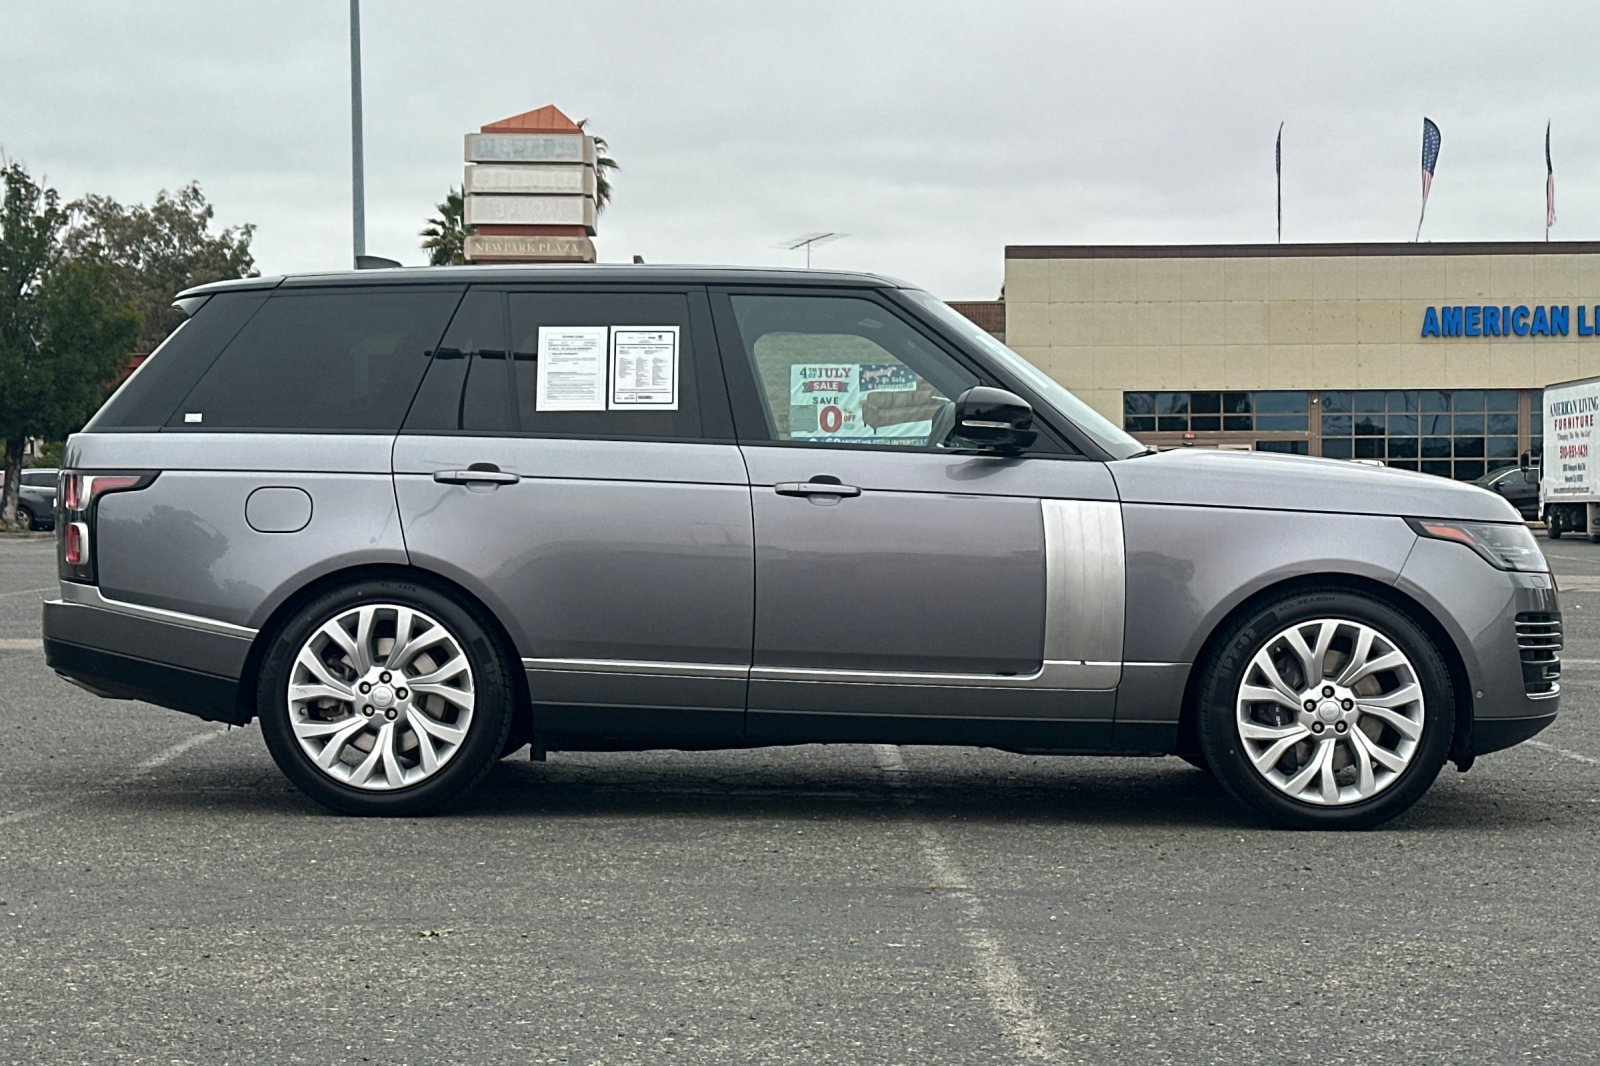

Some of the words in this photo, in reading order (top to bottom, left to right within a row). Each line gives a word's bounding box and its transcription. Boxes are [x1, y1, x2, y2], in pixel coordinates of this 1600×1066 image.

[475, 242, 535, 253] NEWPARK
[539, 242, 579, 253] PLAZA
[1421, 304, 1570, 337] AMERICAN
[800, 366, 807, 379] 4
[817, 367, 852, 378] JULY
[813, 381, 839, 390] SALE
[812, 396, 839, 405] SAVE
[1550, 399, 1578, 417] AMERICAN
[1579, 396, 1599, 414] LIVING
[1554, 414, 1594, 431] FURNITURE
